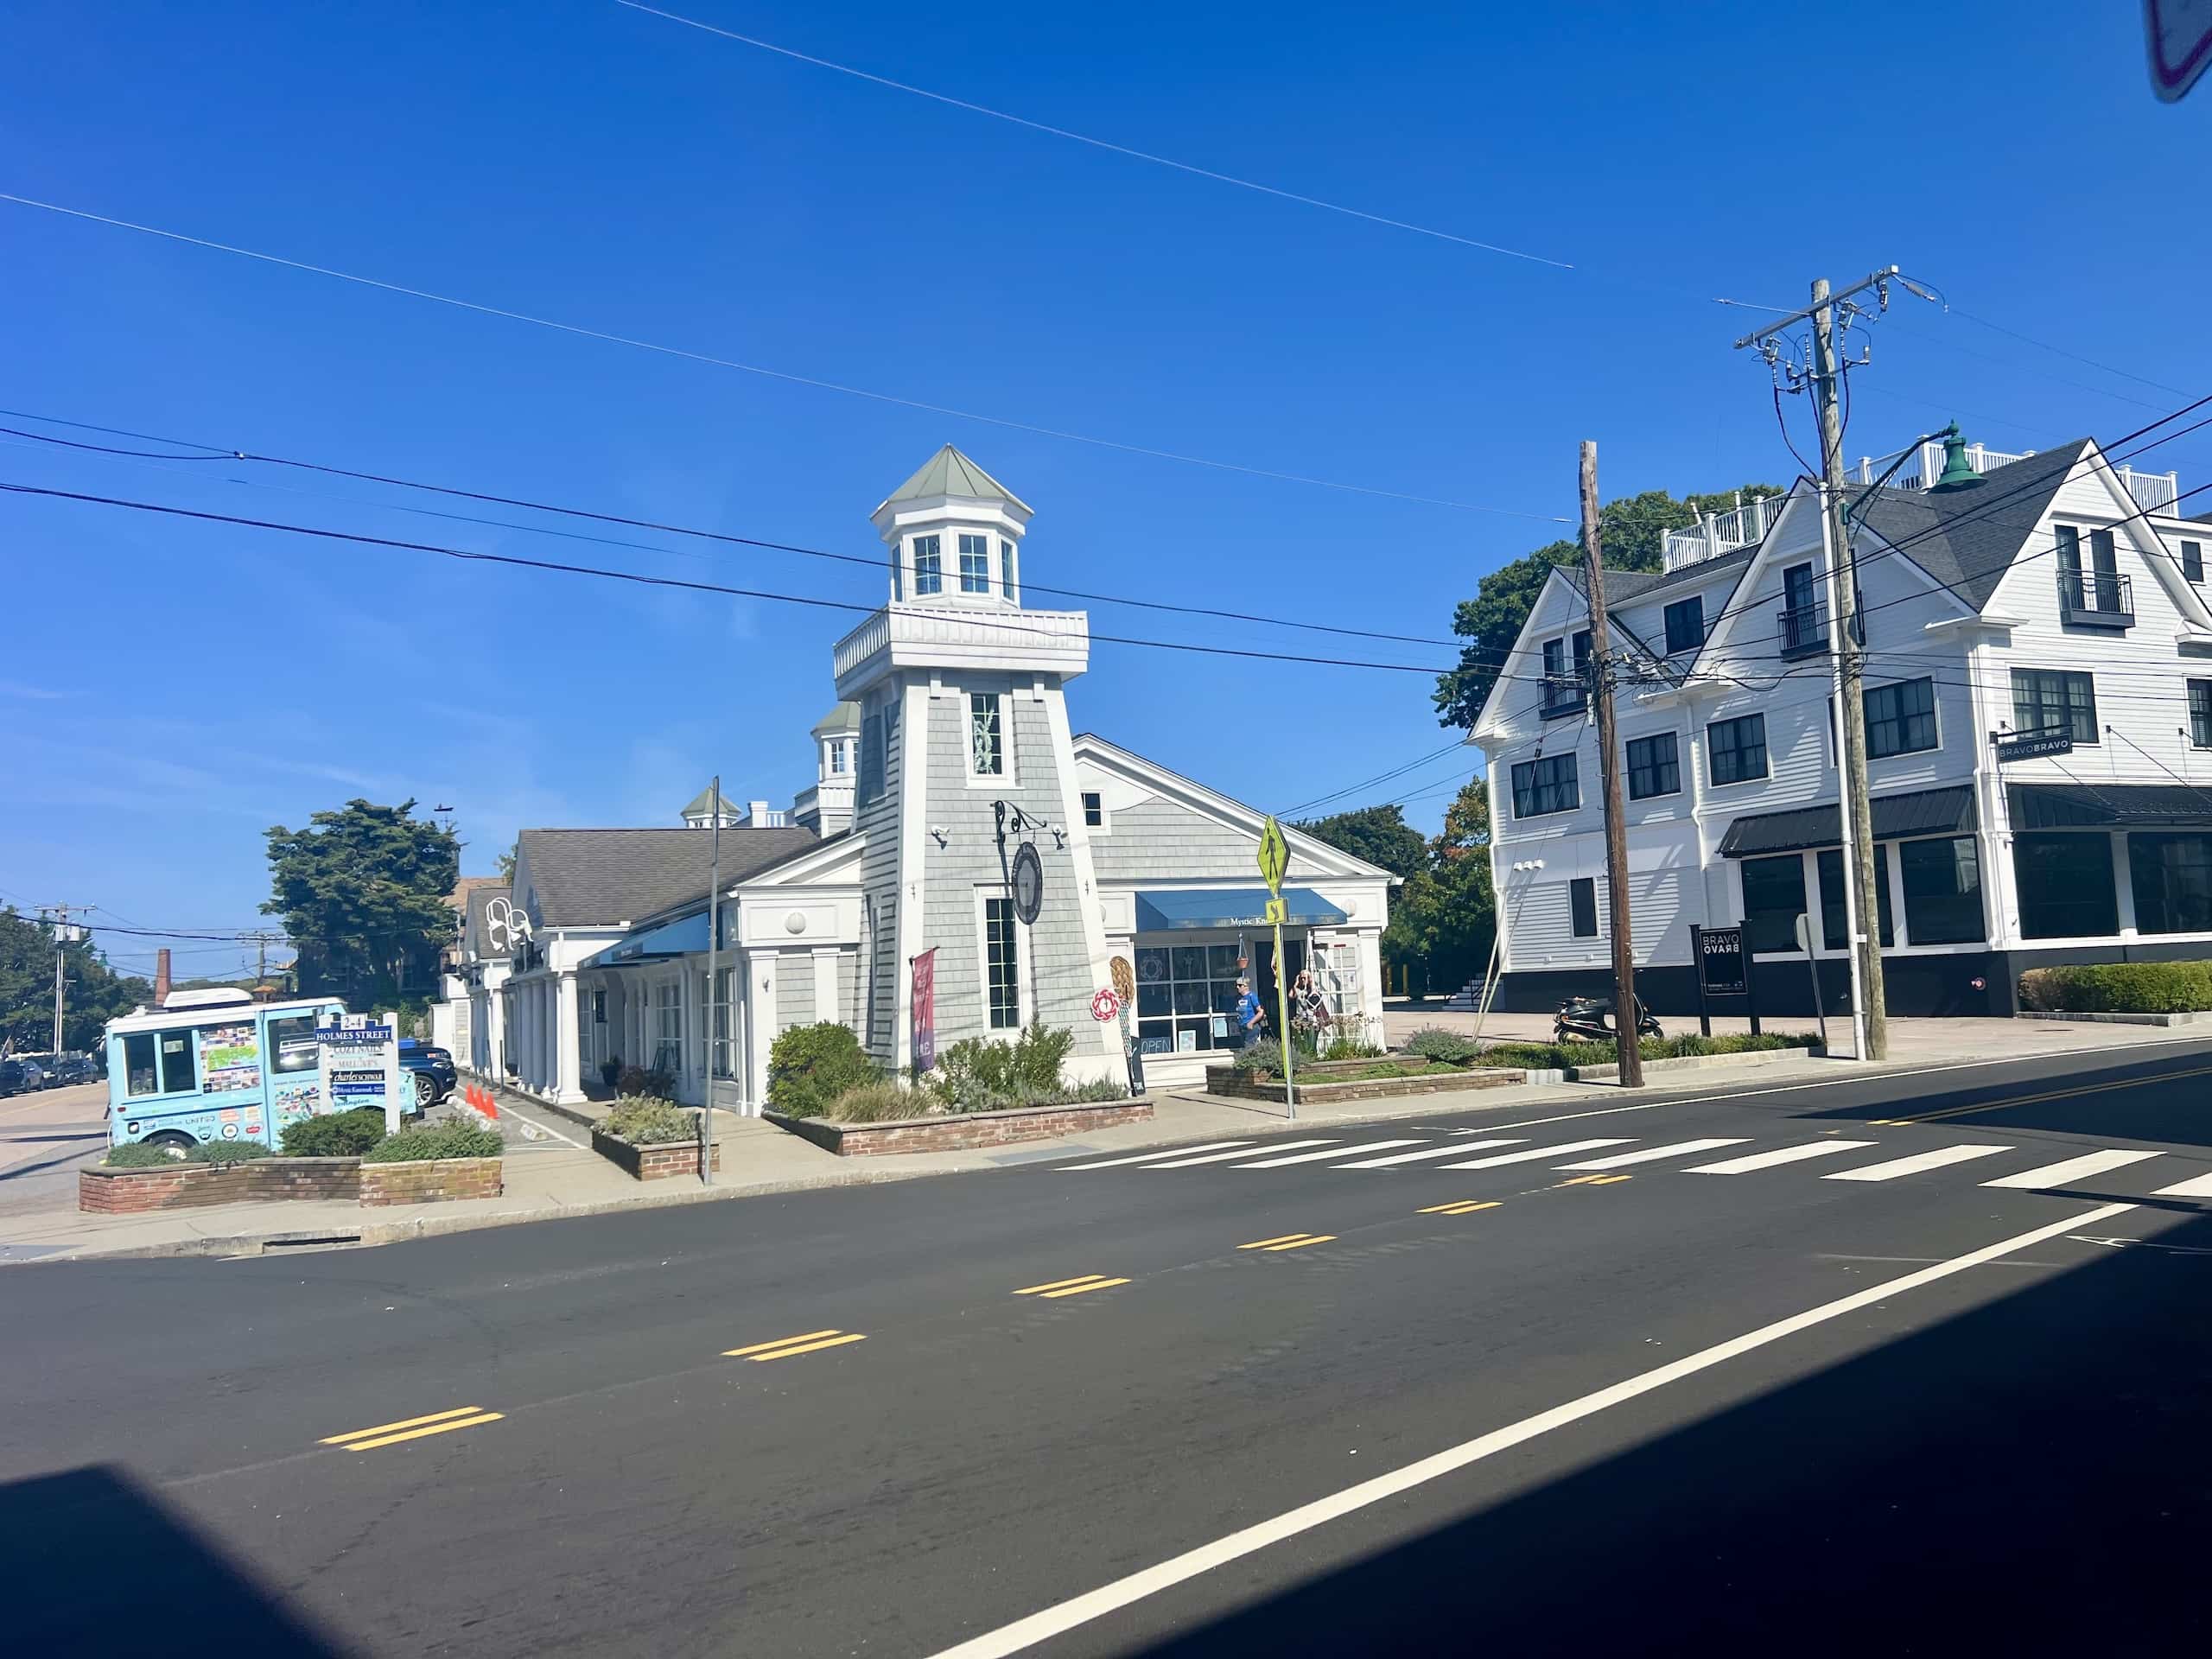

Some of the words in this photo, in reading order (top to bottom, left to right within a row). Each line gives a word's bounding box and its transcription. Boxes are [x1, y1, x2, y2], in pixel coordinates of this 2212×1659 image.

[1230, 918, 1253, 926] Mystic
[1702, 934, 1739, 945] BRAVO
[343, 1016, 362, 1028] 2-4
[316, 1032, 353, 1041] HOLMES
[355, 1030, 390, 1039] STREET
[1141, 1039, 1172, 1053] OPEN
